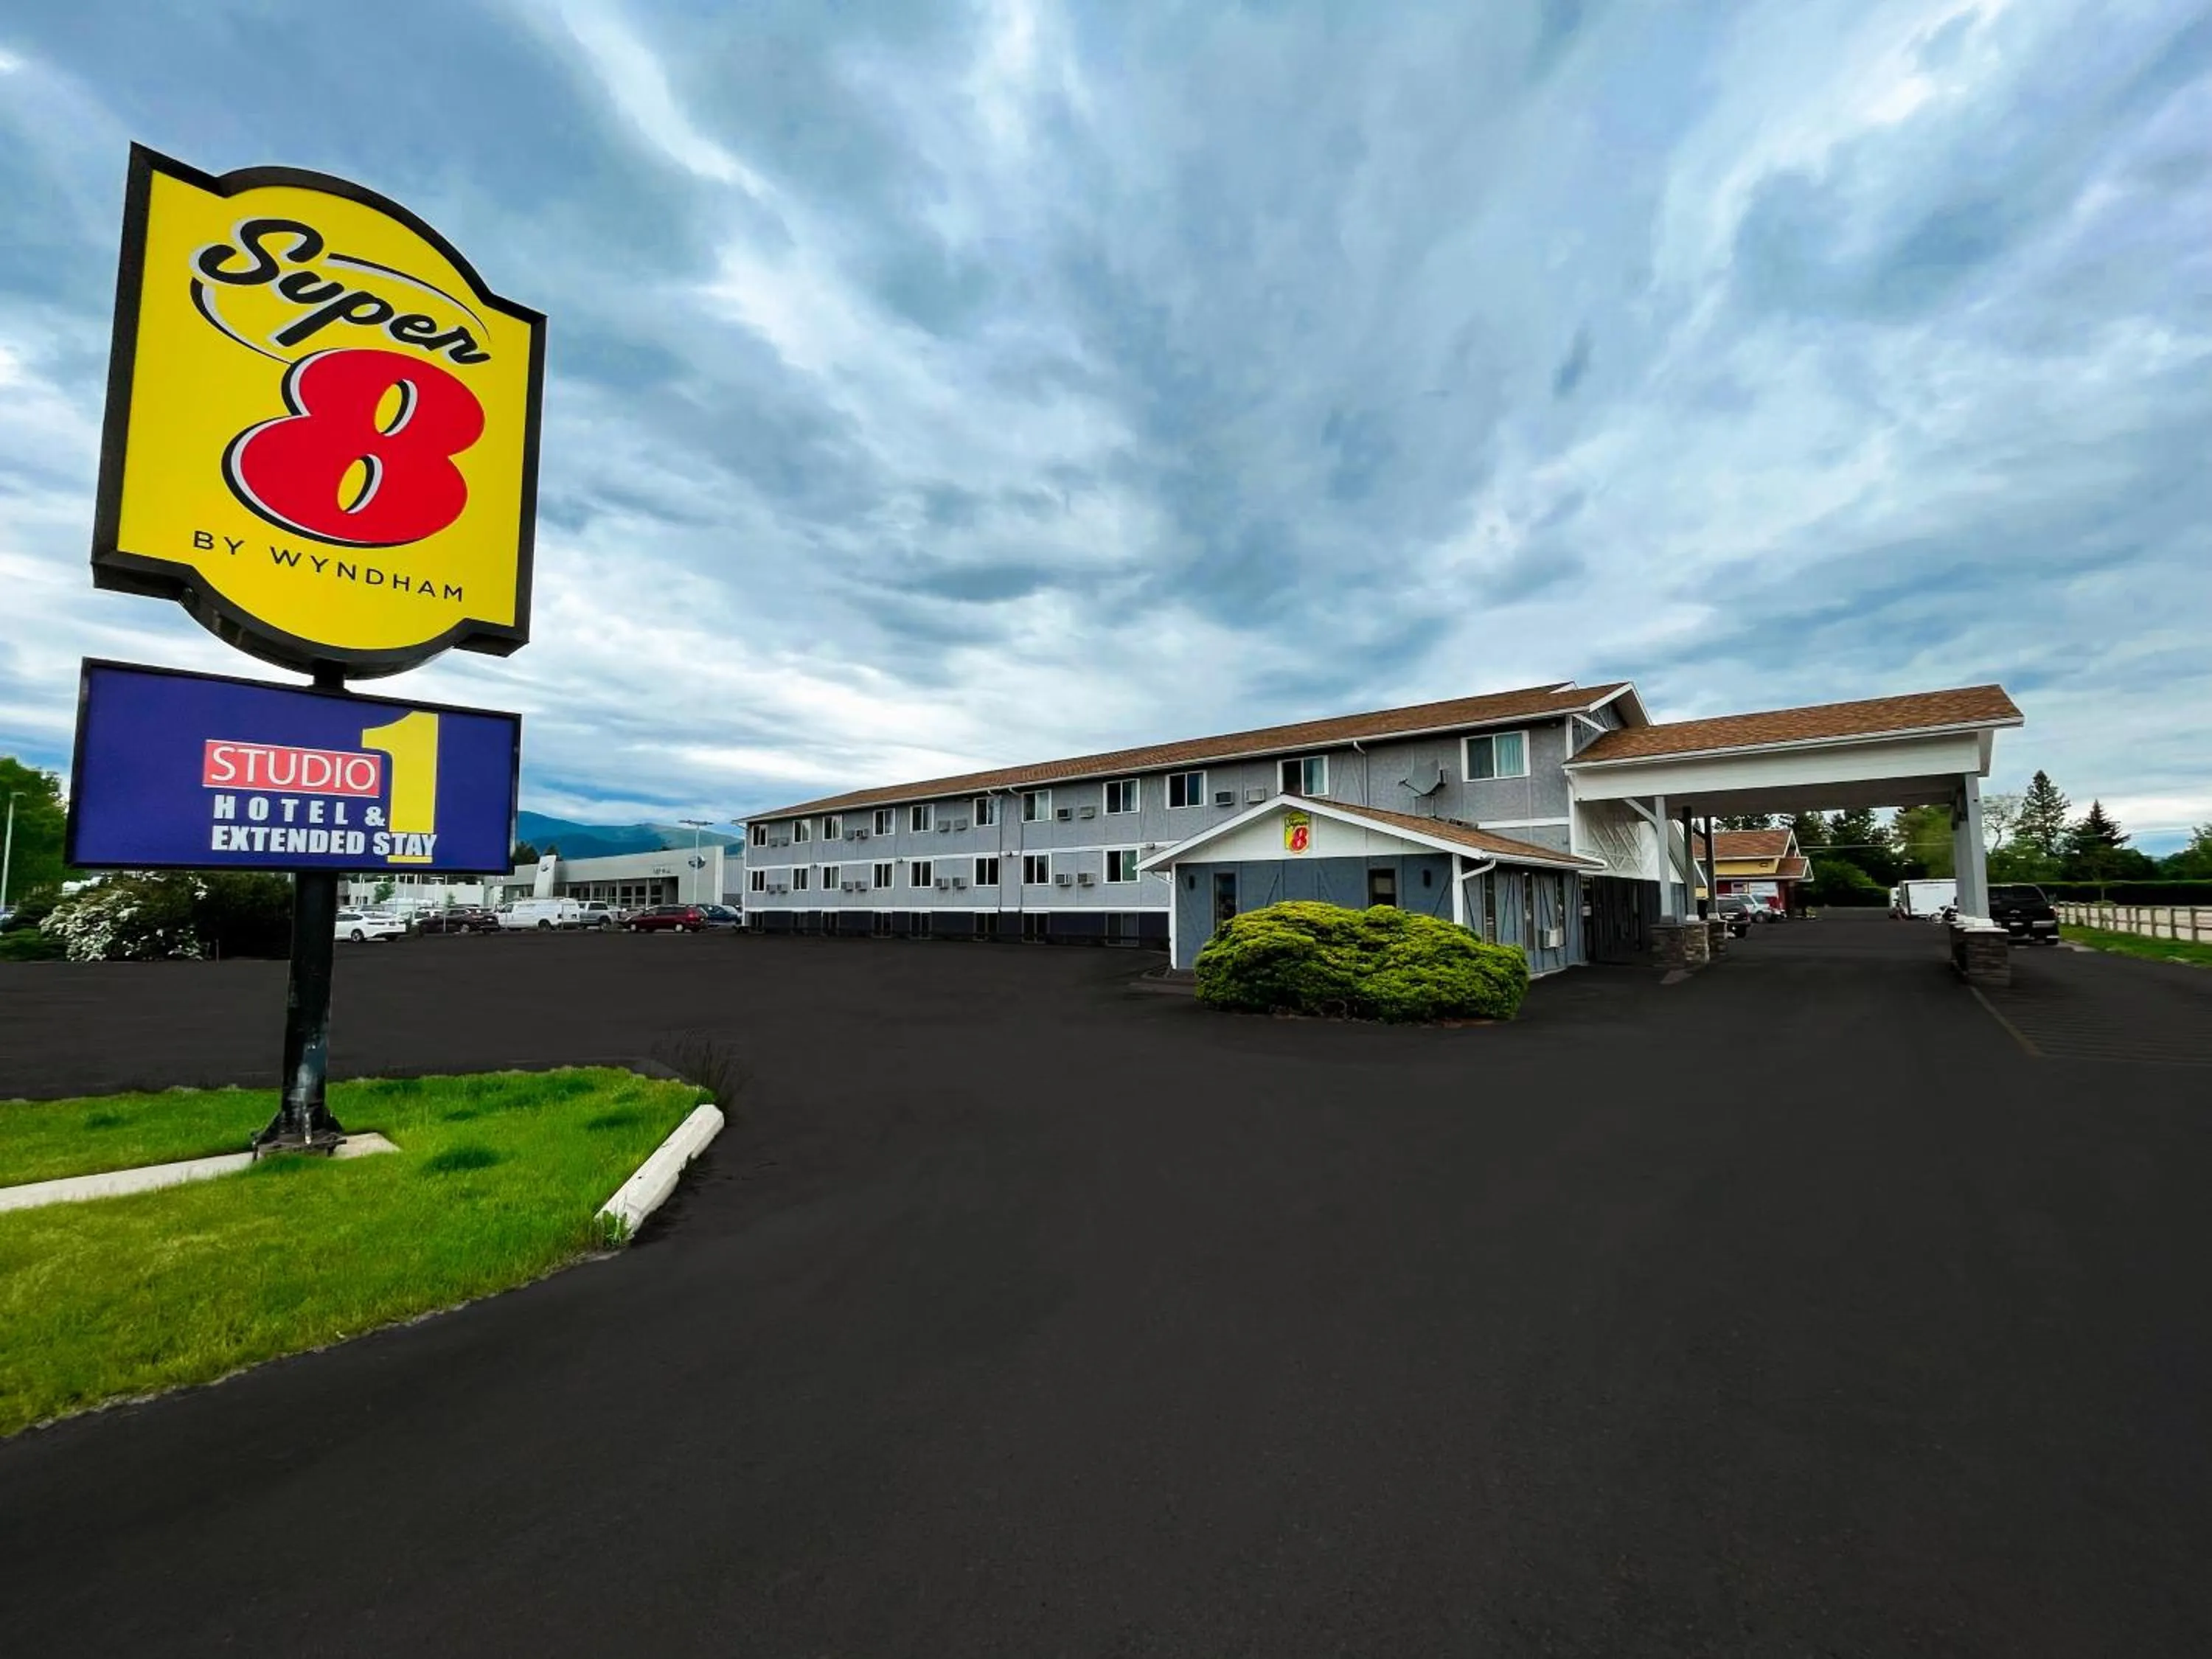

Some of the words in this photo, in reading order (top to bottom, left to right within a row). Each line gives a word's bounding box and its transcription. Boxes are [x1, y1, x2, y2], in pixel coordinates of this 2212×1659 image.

[192, 218, 491, 365] Super
[222, 349, 485, 547] 8
[194, 530, 244, 554] BY
[270, 546, 464, 601] WYNDHAM
[211, 746, 376, 790] STUDIO
[362, 712, 439, 863] 1
[212, 826, 365, 855] EXTENDED
[373, 832, 437, 856] STAY
[214, 795, 349, 824] HOTEL
[364, 807, 386, 827] &
